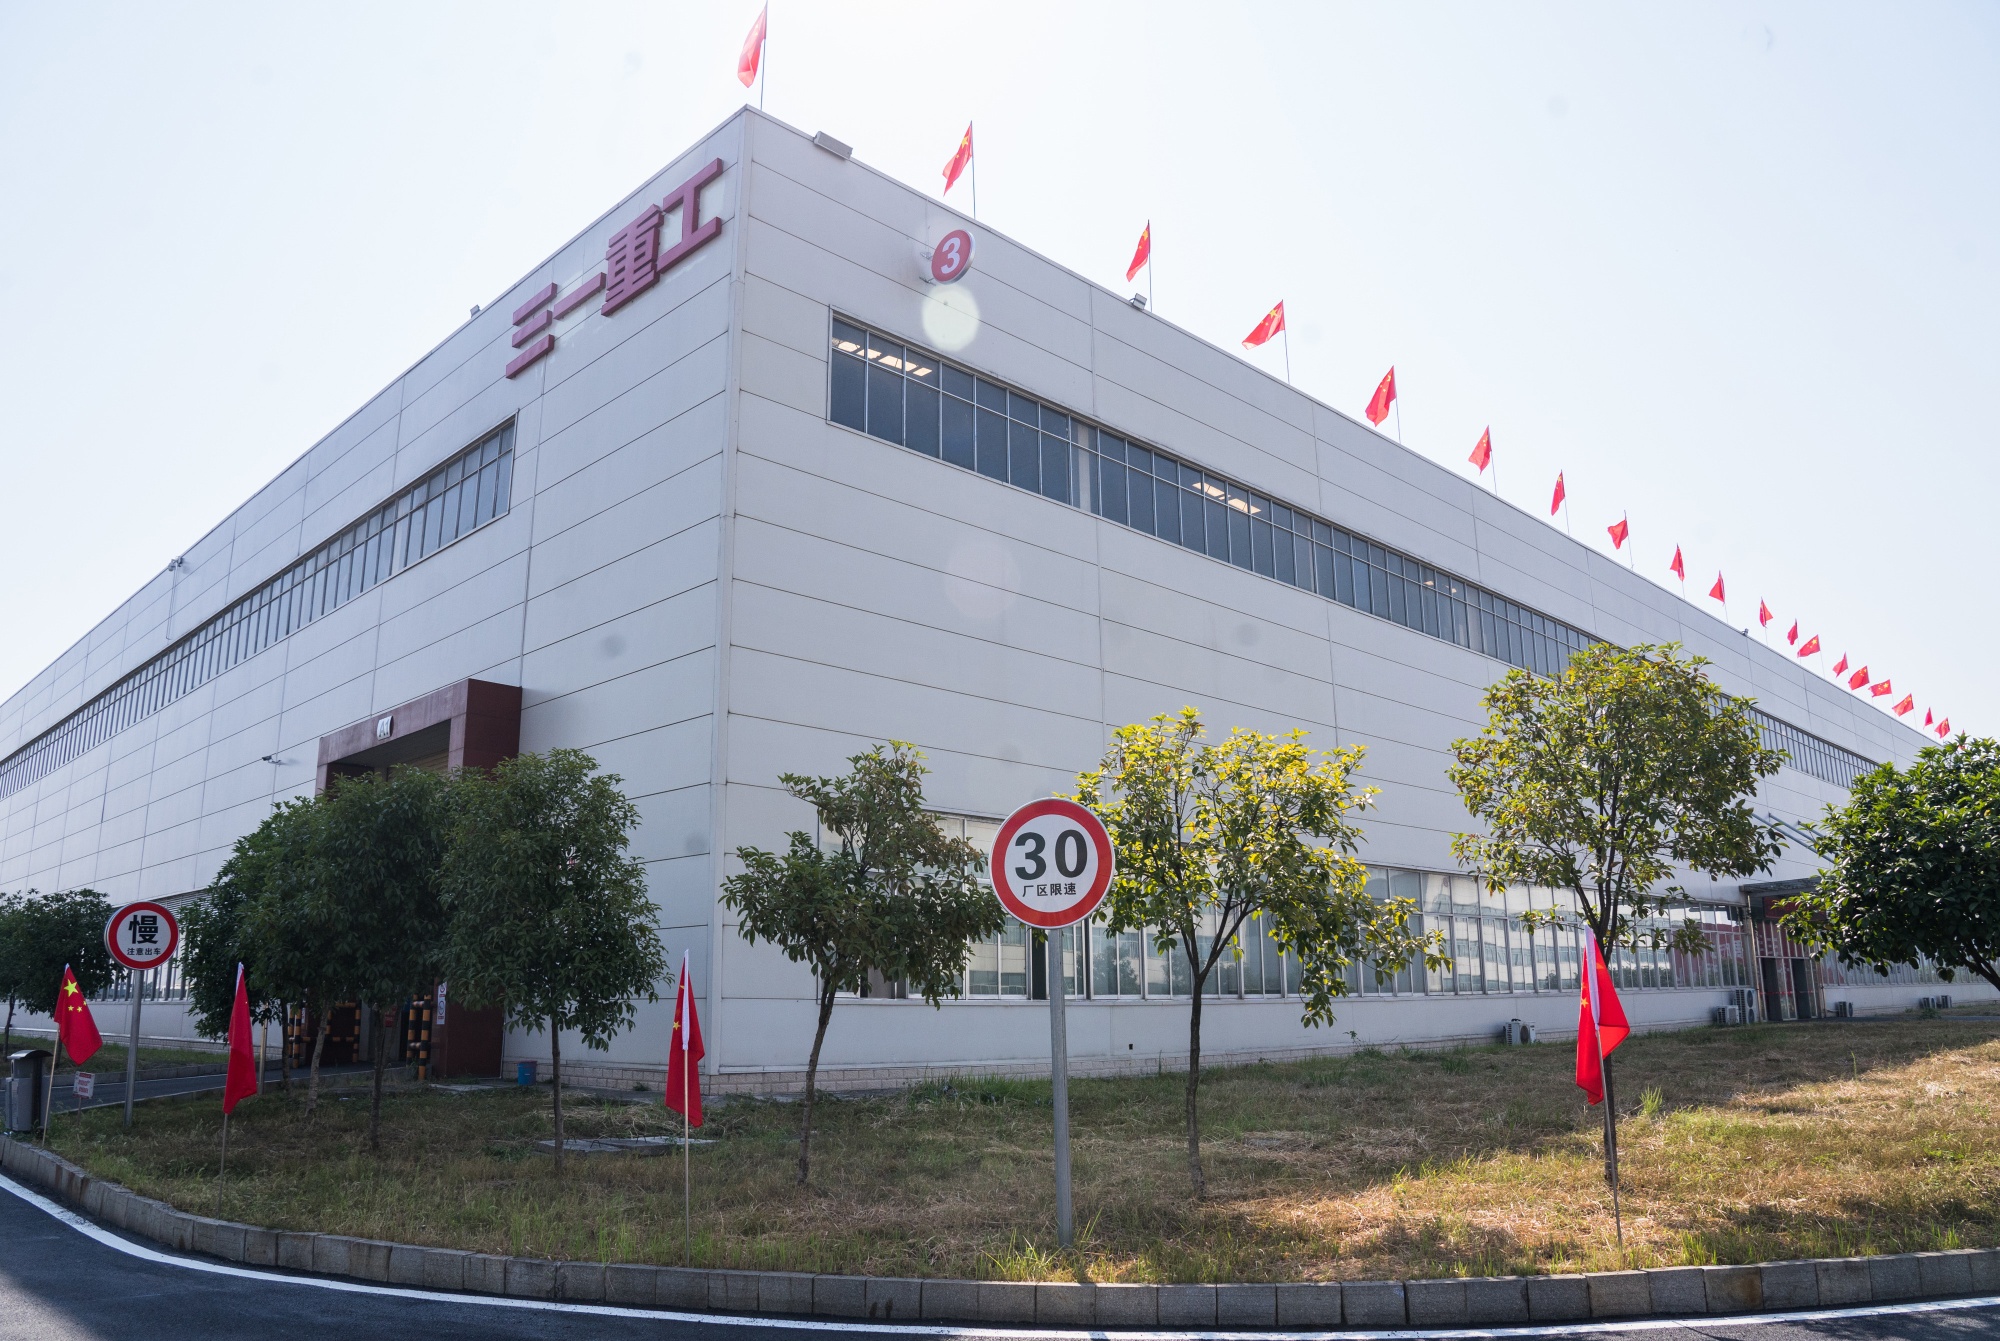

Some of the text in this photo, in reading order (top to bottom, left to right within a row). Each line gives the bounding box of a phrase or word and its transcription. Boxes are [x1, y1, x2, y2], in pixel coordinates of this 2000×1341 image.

[506, 157, 723, 379] 三一重工
[940, 237, 960, 274] 3
[1015, 829, 1088, 880] 30
[1022, 882, 1077, 897] 厂区限速
[128, 915, 158, 944] 慢
